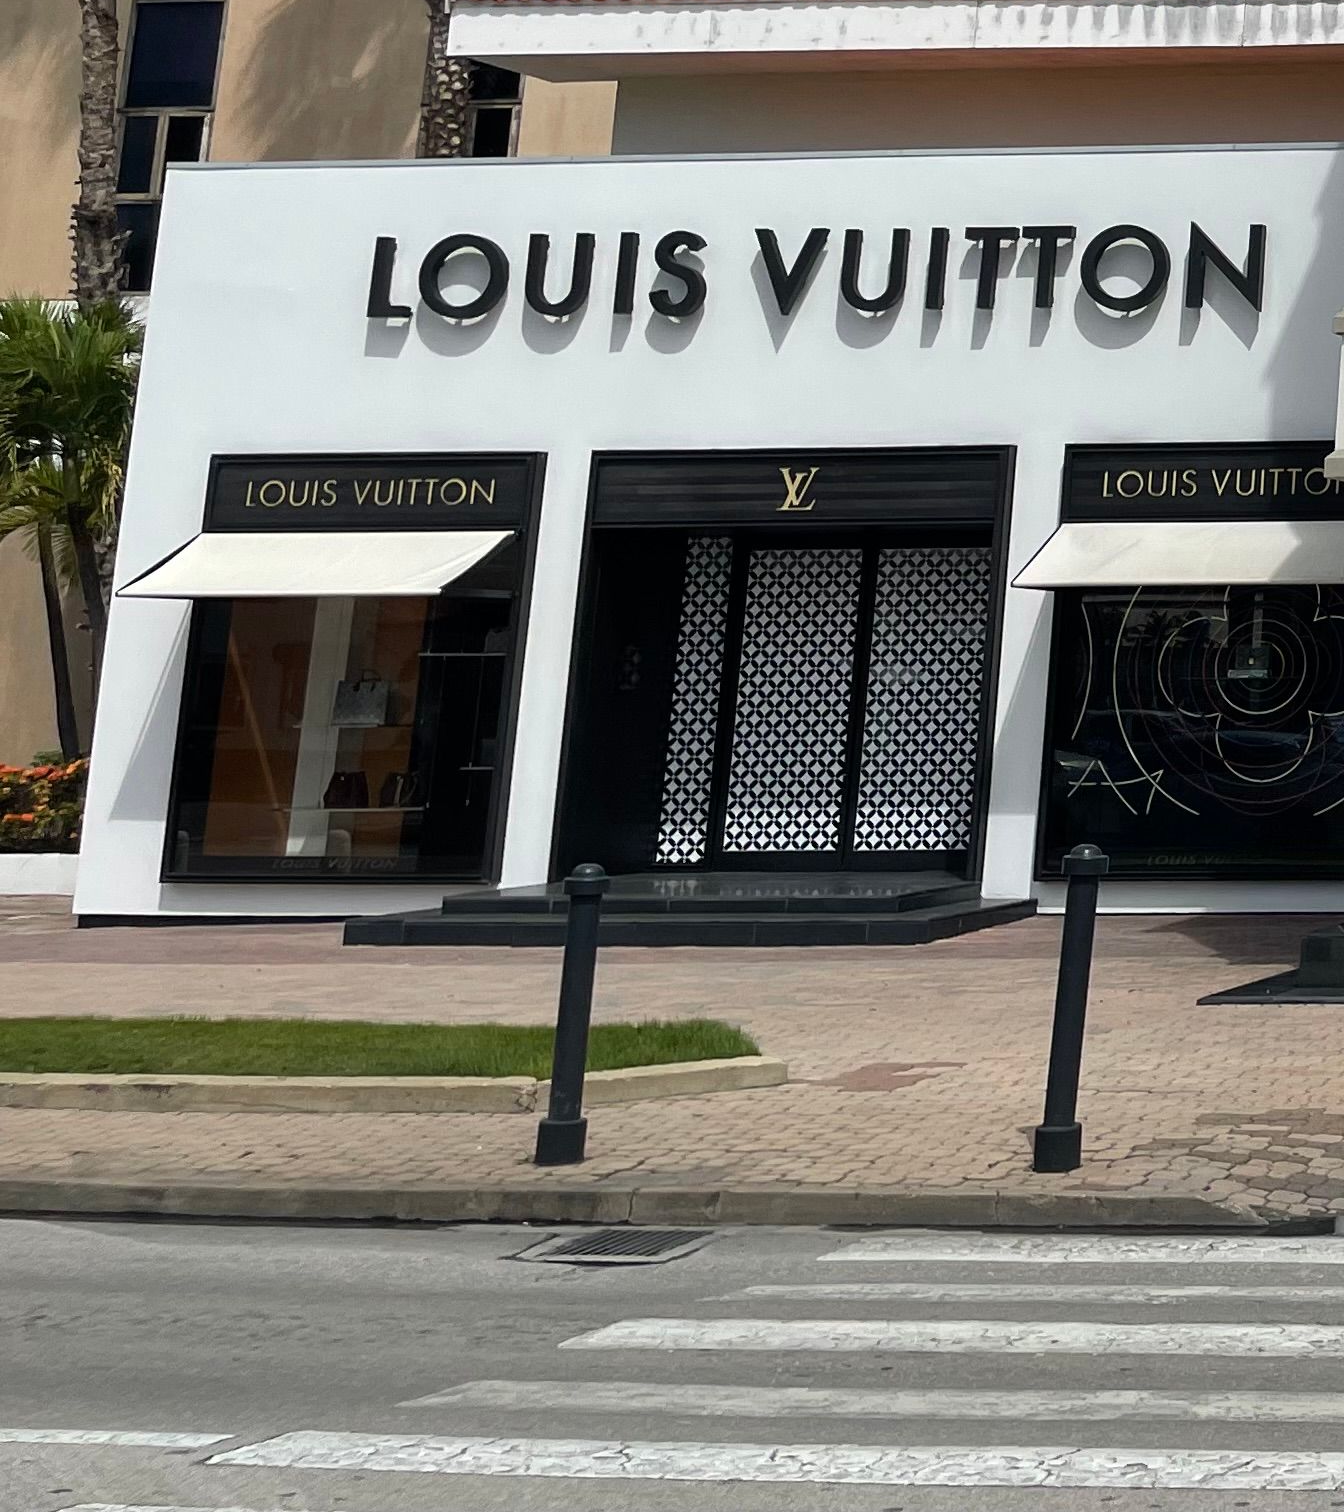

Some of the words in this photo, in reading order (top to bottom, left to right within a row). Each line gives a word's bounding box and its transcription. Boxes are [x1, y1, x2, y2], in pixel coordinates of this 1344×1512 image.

[366, 230, 708, 319] LOUIS
[754, 221, 1267, 316] VUITTON
[245, 479, 338, 508] LOUIS
[353, 477, 496, 507] VUITTON
[1101, 469, 1198, 499] LOUIS
